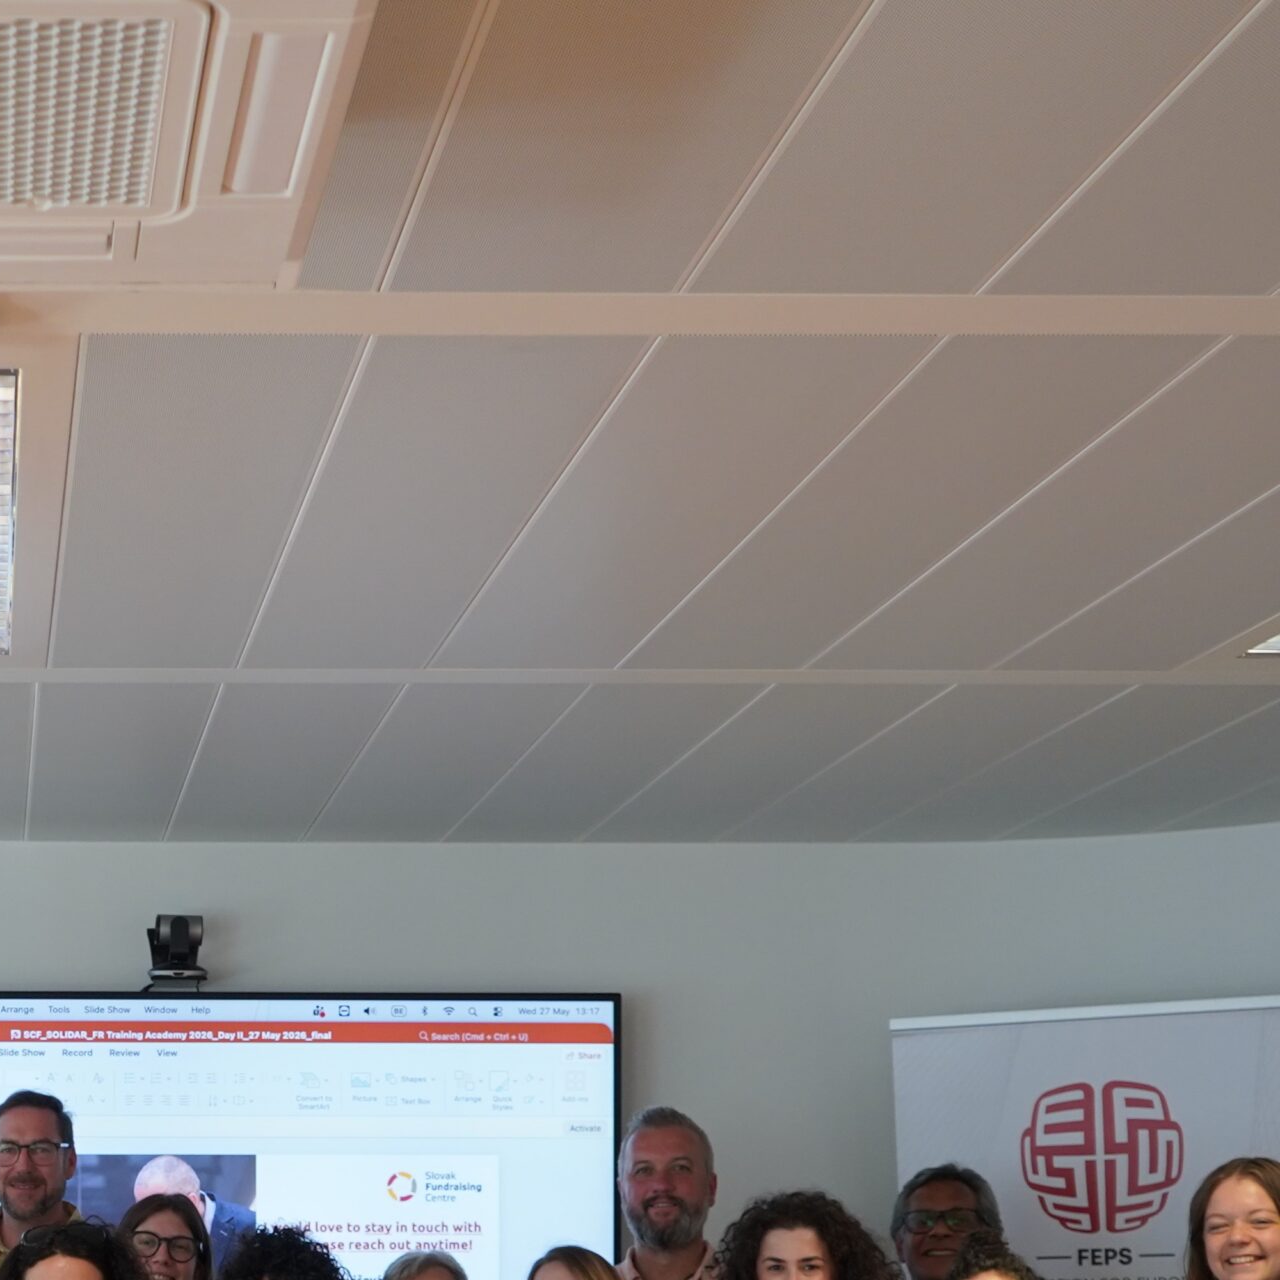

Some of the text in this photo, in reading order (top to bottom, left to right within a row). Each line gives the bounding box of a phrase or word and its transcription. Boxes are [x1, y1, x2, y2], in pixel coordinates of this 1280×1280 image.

[0, 1005, 35, 1017] Arrange
[48, 1005, 70, 1014] Tools
[84, 1005, 131, 1015] Slide Show
[144, 1006, 178, 1015] Window
[191, 1006, 211, 1017] Help
[518, 1007, 600, 1018] Wed 27 May 13:17
[23, 1030, 105, 1041] SCF_SOLIDAR_FR
[106, 1031, 143, 1041] Training
[145, 1031, 187, 1041] Academy
[189, 1031, 235, 1041] 2026_Day
[262, 1031, 281, 1041] May
[283, 1031, 332, 1041] 2026_final
[431, 1032, 460, 1041] Search
[20, 1048, 45, 1057] Show
[62, 1048, 93, 1057] Record
[109, 1048, 140, 1057] Review
[157, 1048, 178, 1057] View
[578, 1051, 602, 1060] Share
[569, 1124, 602, 1133] Activate
[425, 1171, 456, 1180] Slovak
[425, 1182, 482, 1193] Fundraising
[425, 1193, 456, 1202] Centre
[315, 1222, 344, 1233] love
[347, 1223, 361, 1233] to
[365, 1223, 392, 1236] stay
[396, 1222, 408, 1233] in
[412, 1222, 449, 1233] touch
[453, 1222, 482, 1233] with
[348, 1239, 385, 1250] reach
[391, 1240, 411, 1250] out
[415, 1239, 473, 1252] anytime!
[1077, 1248, 1133, 1266] FEPS
